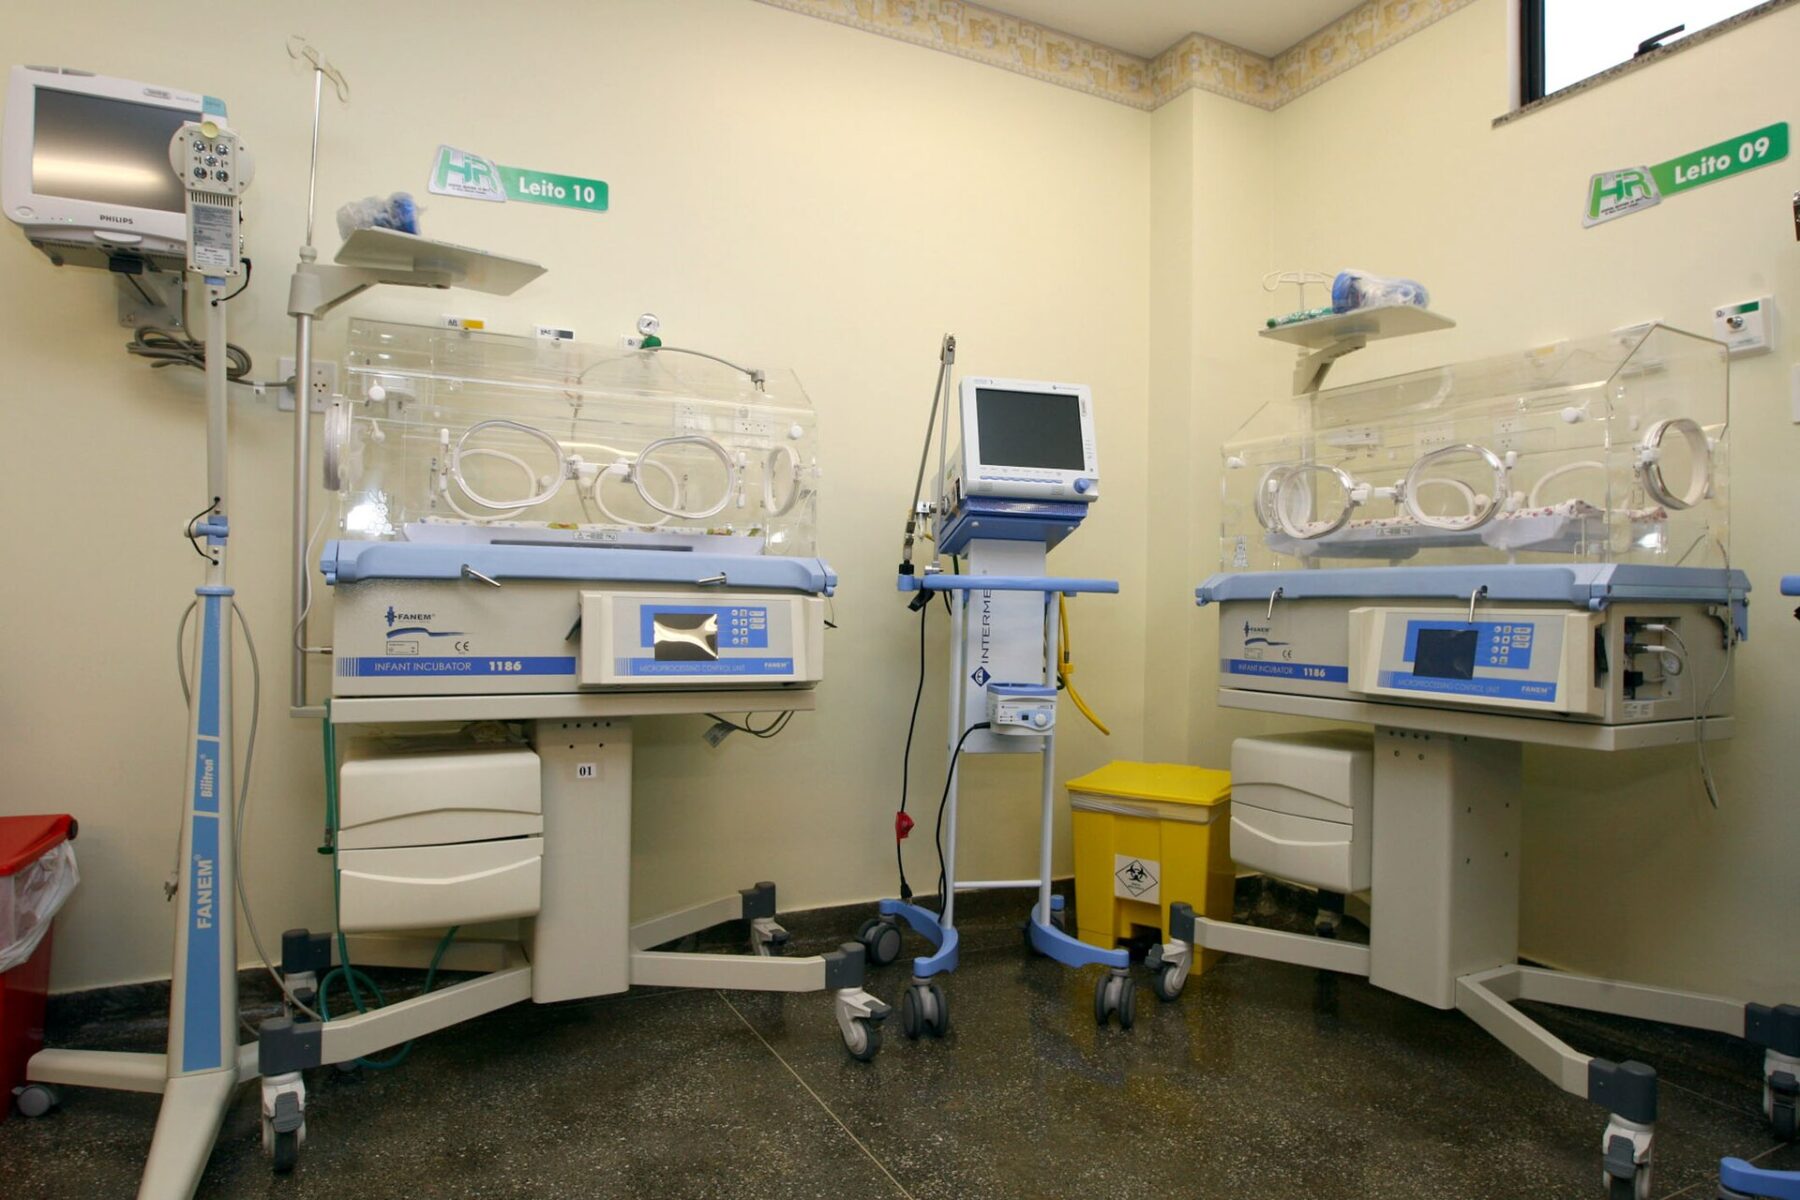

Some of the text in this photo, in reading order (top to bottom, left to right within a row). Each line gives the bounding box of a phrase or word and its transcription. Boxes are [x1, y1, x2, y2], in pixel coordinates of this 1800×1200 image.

[1674, 136, 1770, 184] Leito 09
[519, 177, 596, 203] Leito 10
[100, 214, 133, 224] PHILIPS
[981, 588, 992, 664] INTERME
[374, 662, 472, 672] INFANT INCUBATOR
[489, 661, 522, 671] 1186
[1303, 668, 1326, 678] 1186
[1521, 685, 1548, 694] FANEM
[579, 766, 592, 776] 01
[200, 759, 213, 798] Bilitron
[197, 860, 213, 929] FANEM
